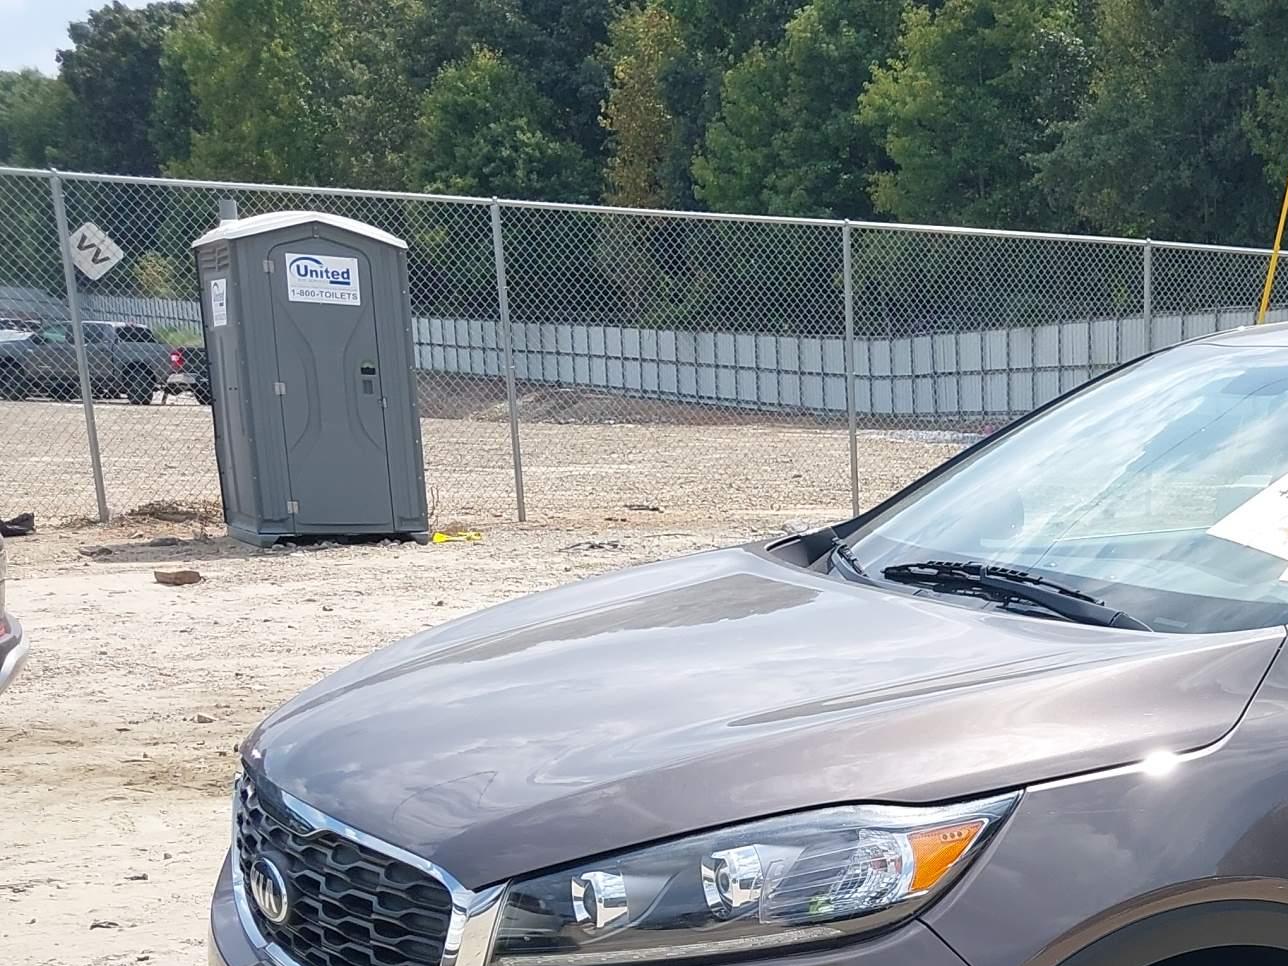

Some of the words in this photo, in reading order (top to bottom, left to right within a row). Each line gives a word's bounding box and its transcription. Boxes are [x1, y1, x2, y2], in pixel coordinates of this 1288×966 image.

[296, 264, 351, 280] United
[291, 289, 358, 300] 1-800-TOILETS
[251, 869, 279, 914] KIA
